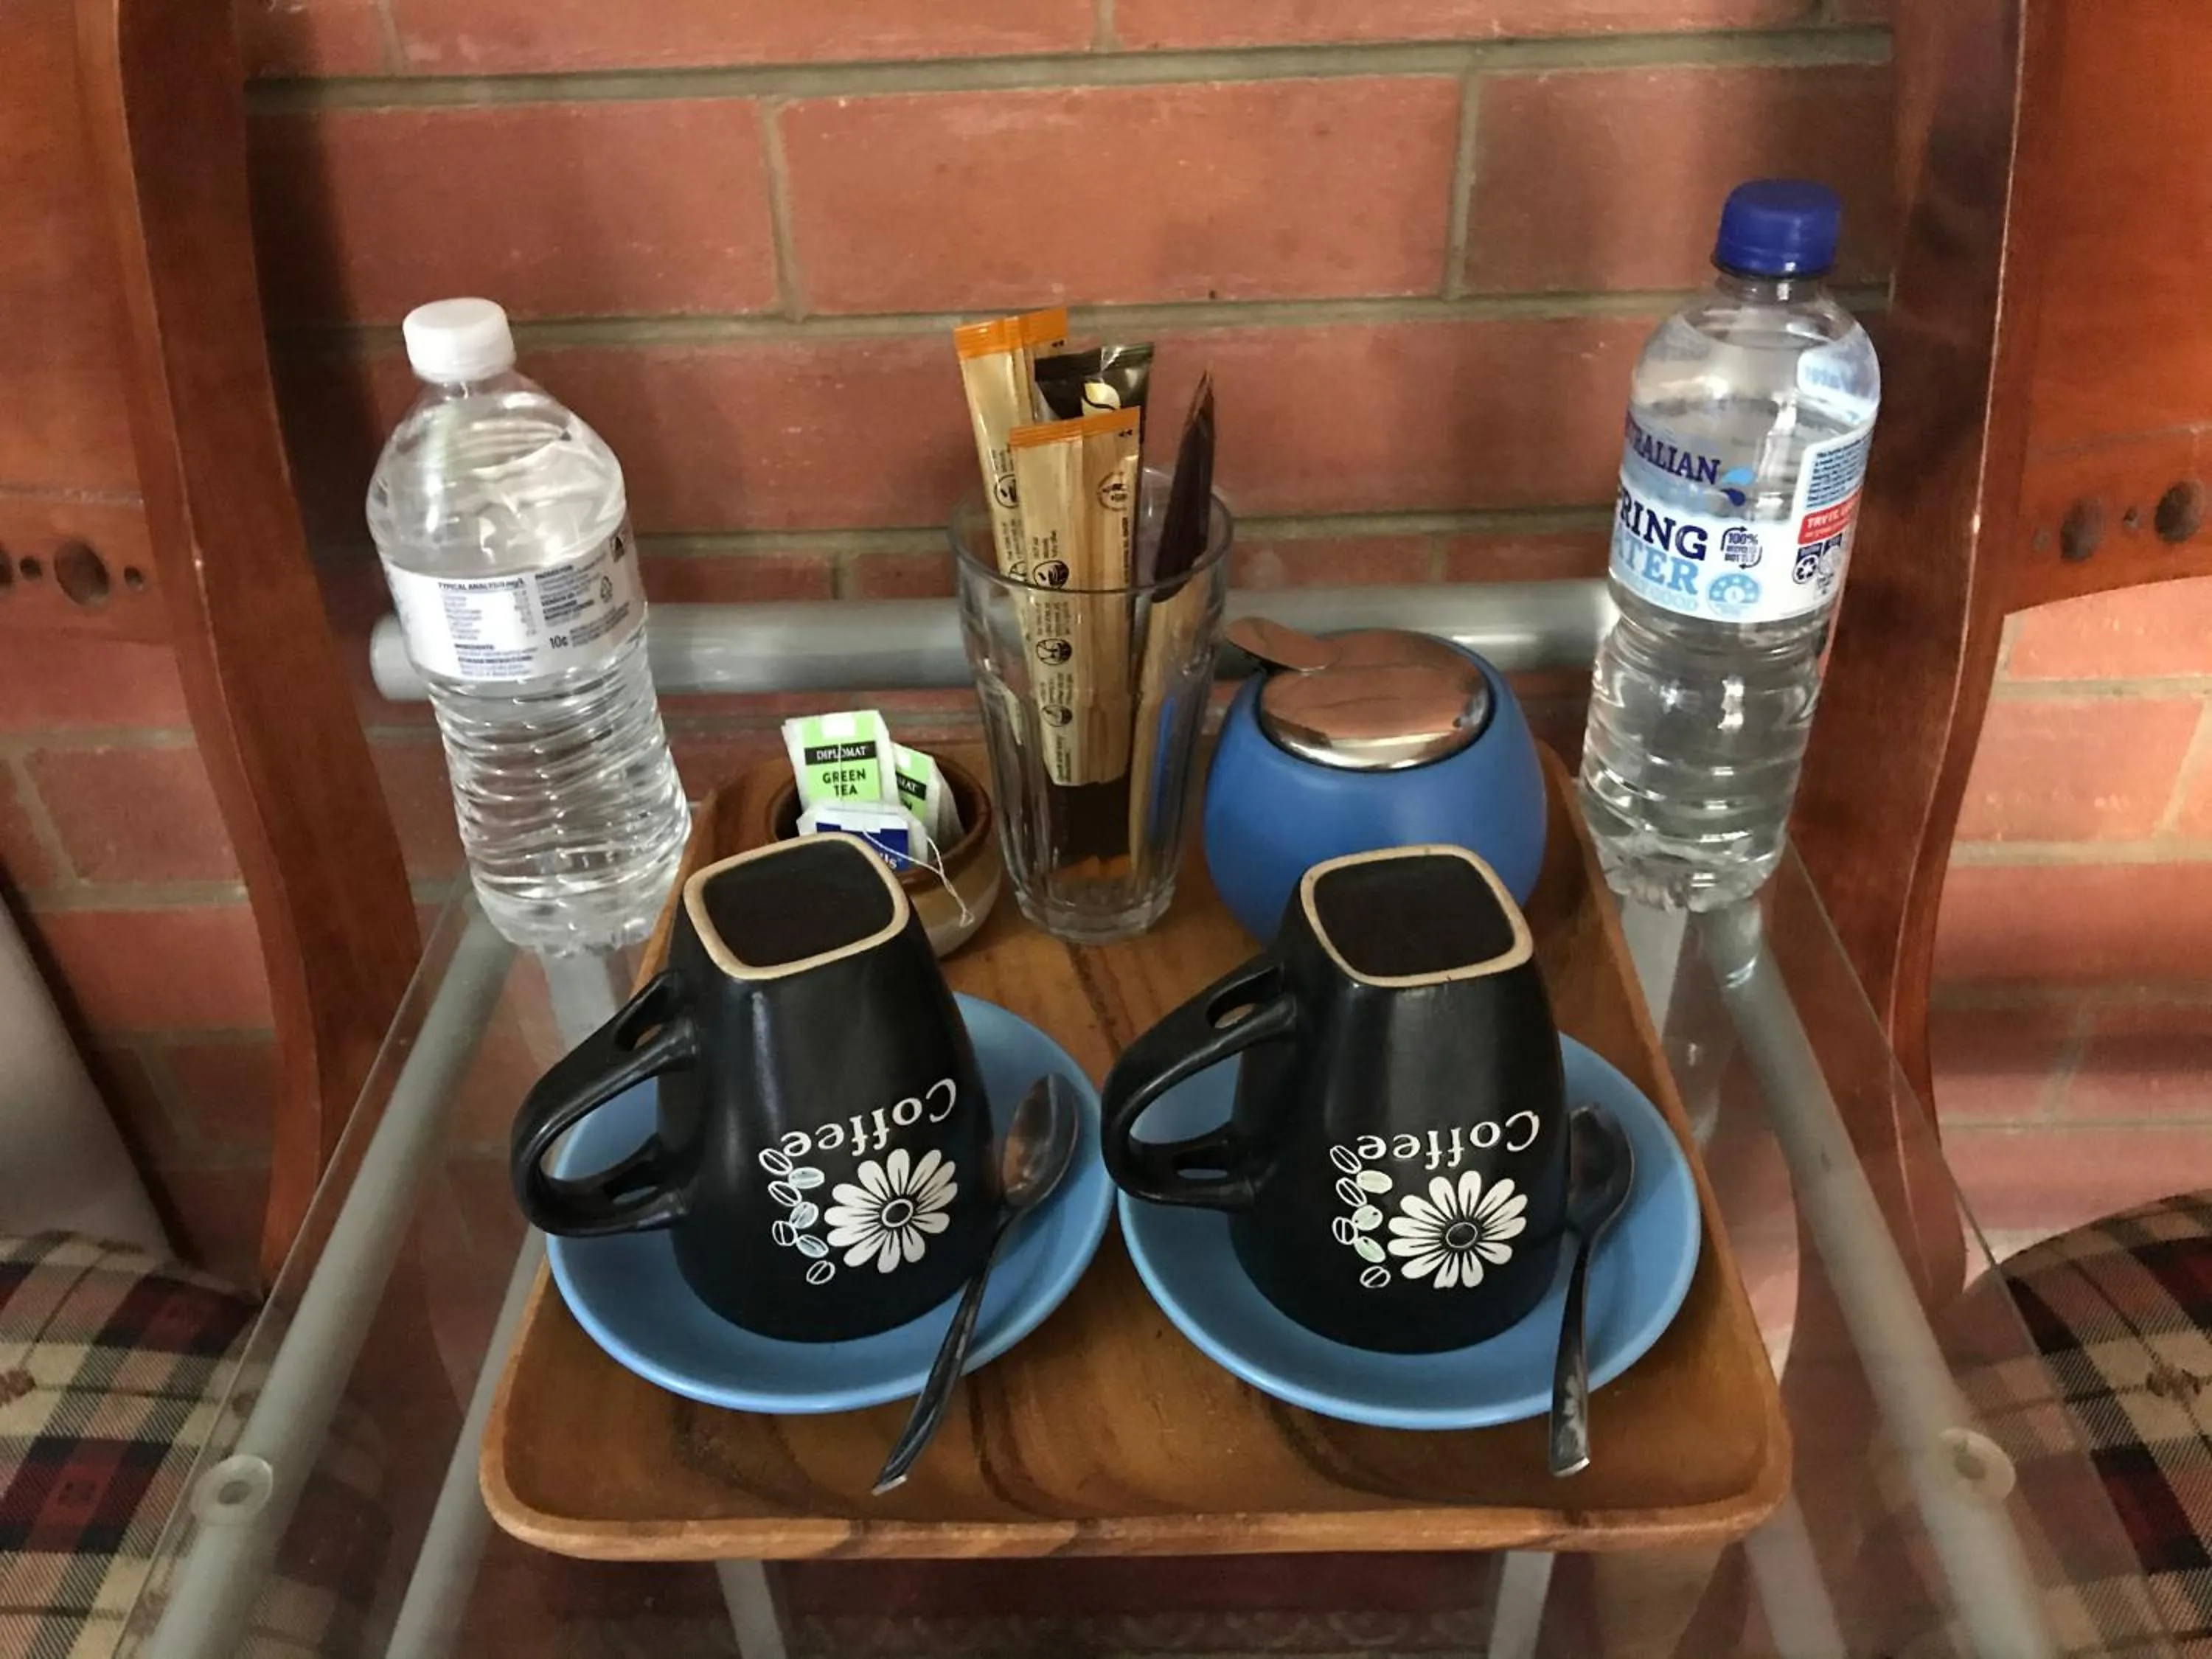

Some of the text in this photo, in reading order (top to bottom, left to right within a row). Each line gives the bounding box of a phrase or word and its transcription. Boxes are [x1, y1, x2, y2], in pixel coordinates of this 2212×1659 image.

[1619, 483, 1708, 561] RING
[816, 745, 867, 761] DIPLOMAT
[822, 768, 866, 785] GREEN
[833, 784, 858, 797] TEA
[780, 1078, 956, 1157] Coffee
[1357, 1110, 1540, 1169] Coffee
